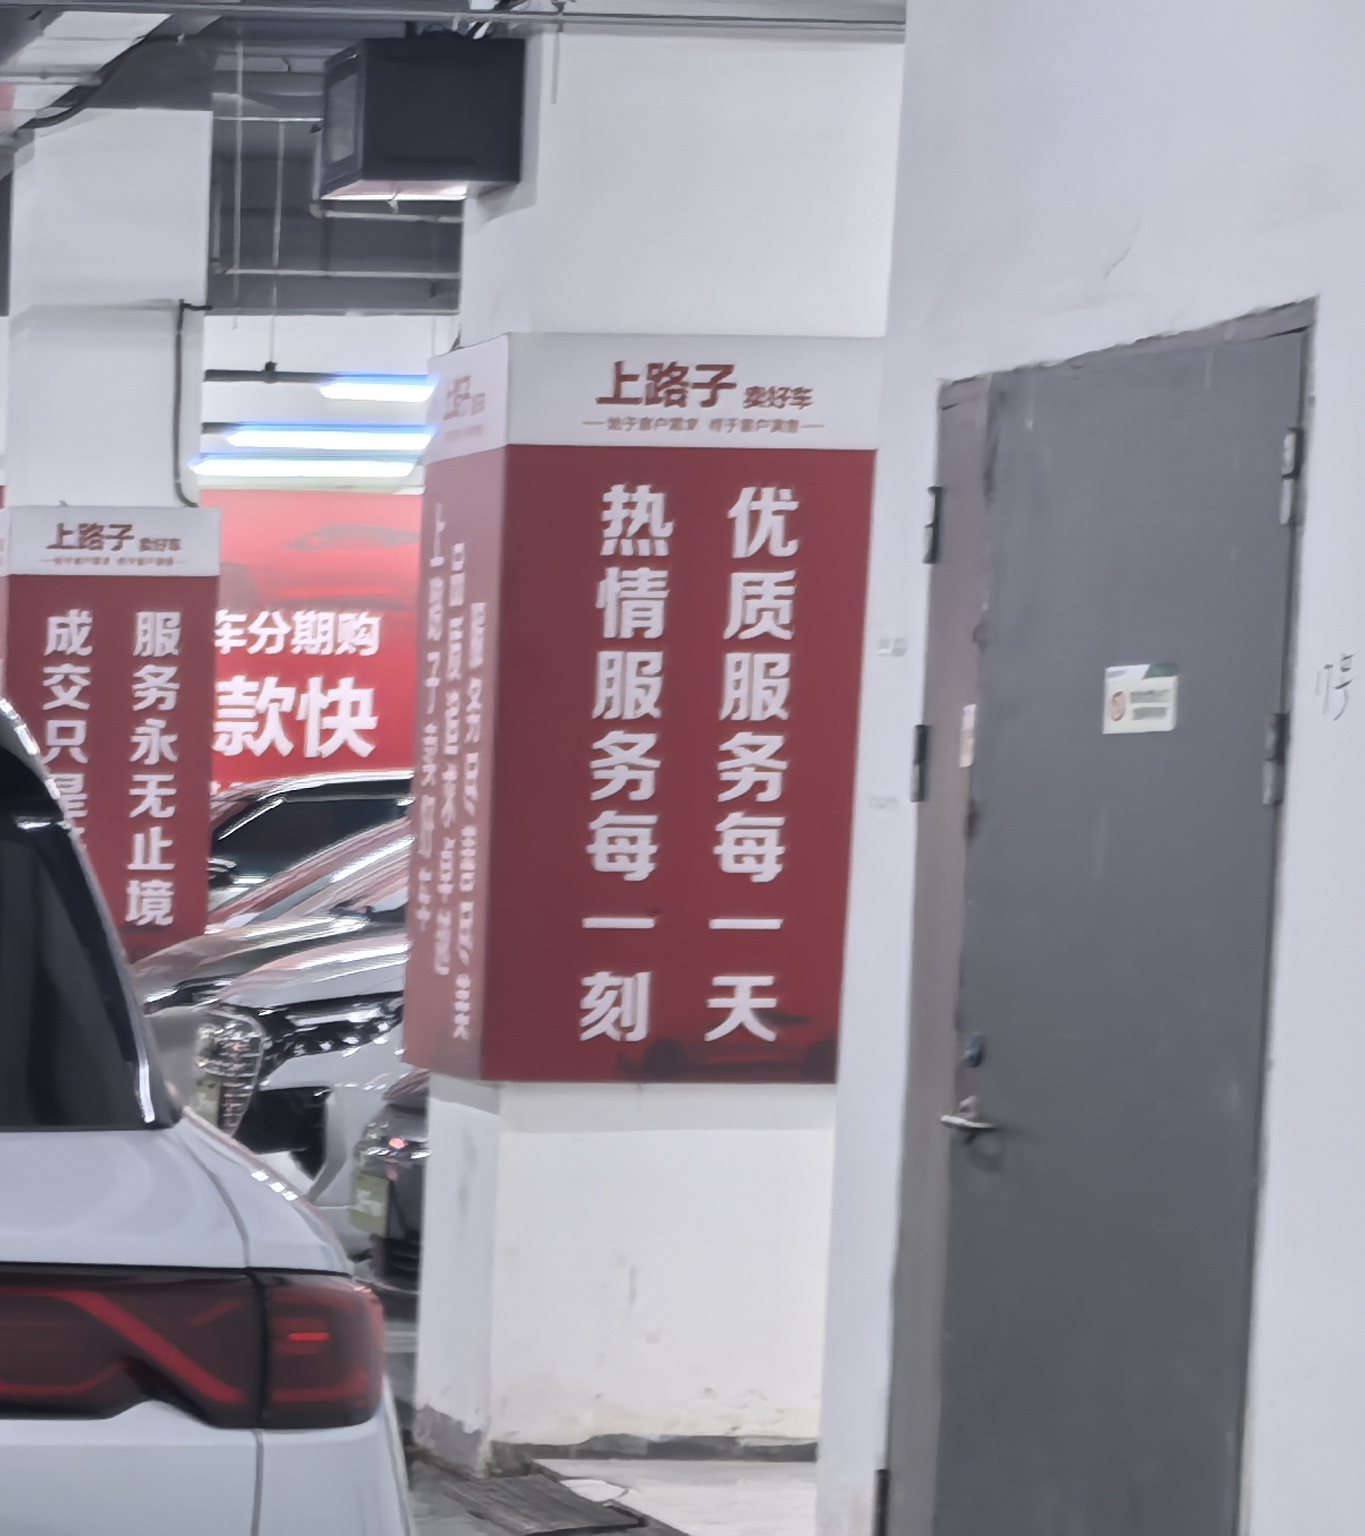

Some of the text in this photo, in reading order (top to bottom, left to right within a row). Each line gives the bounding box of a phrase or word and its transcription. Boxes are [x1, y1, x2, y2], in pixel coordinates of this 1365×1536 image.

[594, 360, 737, 408] 上路子
[46, 522, 136, 551] 上路子
[41, 608, 94, 852] 成交只是
[125, 611, 182, 927] 服务永无止境
[211, 674, 380, 759] 款快
[578, 482, 675, 1044] 热情服务每一刻
[703, 483, 801, 1044] 优质服务每一天
